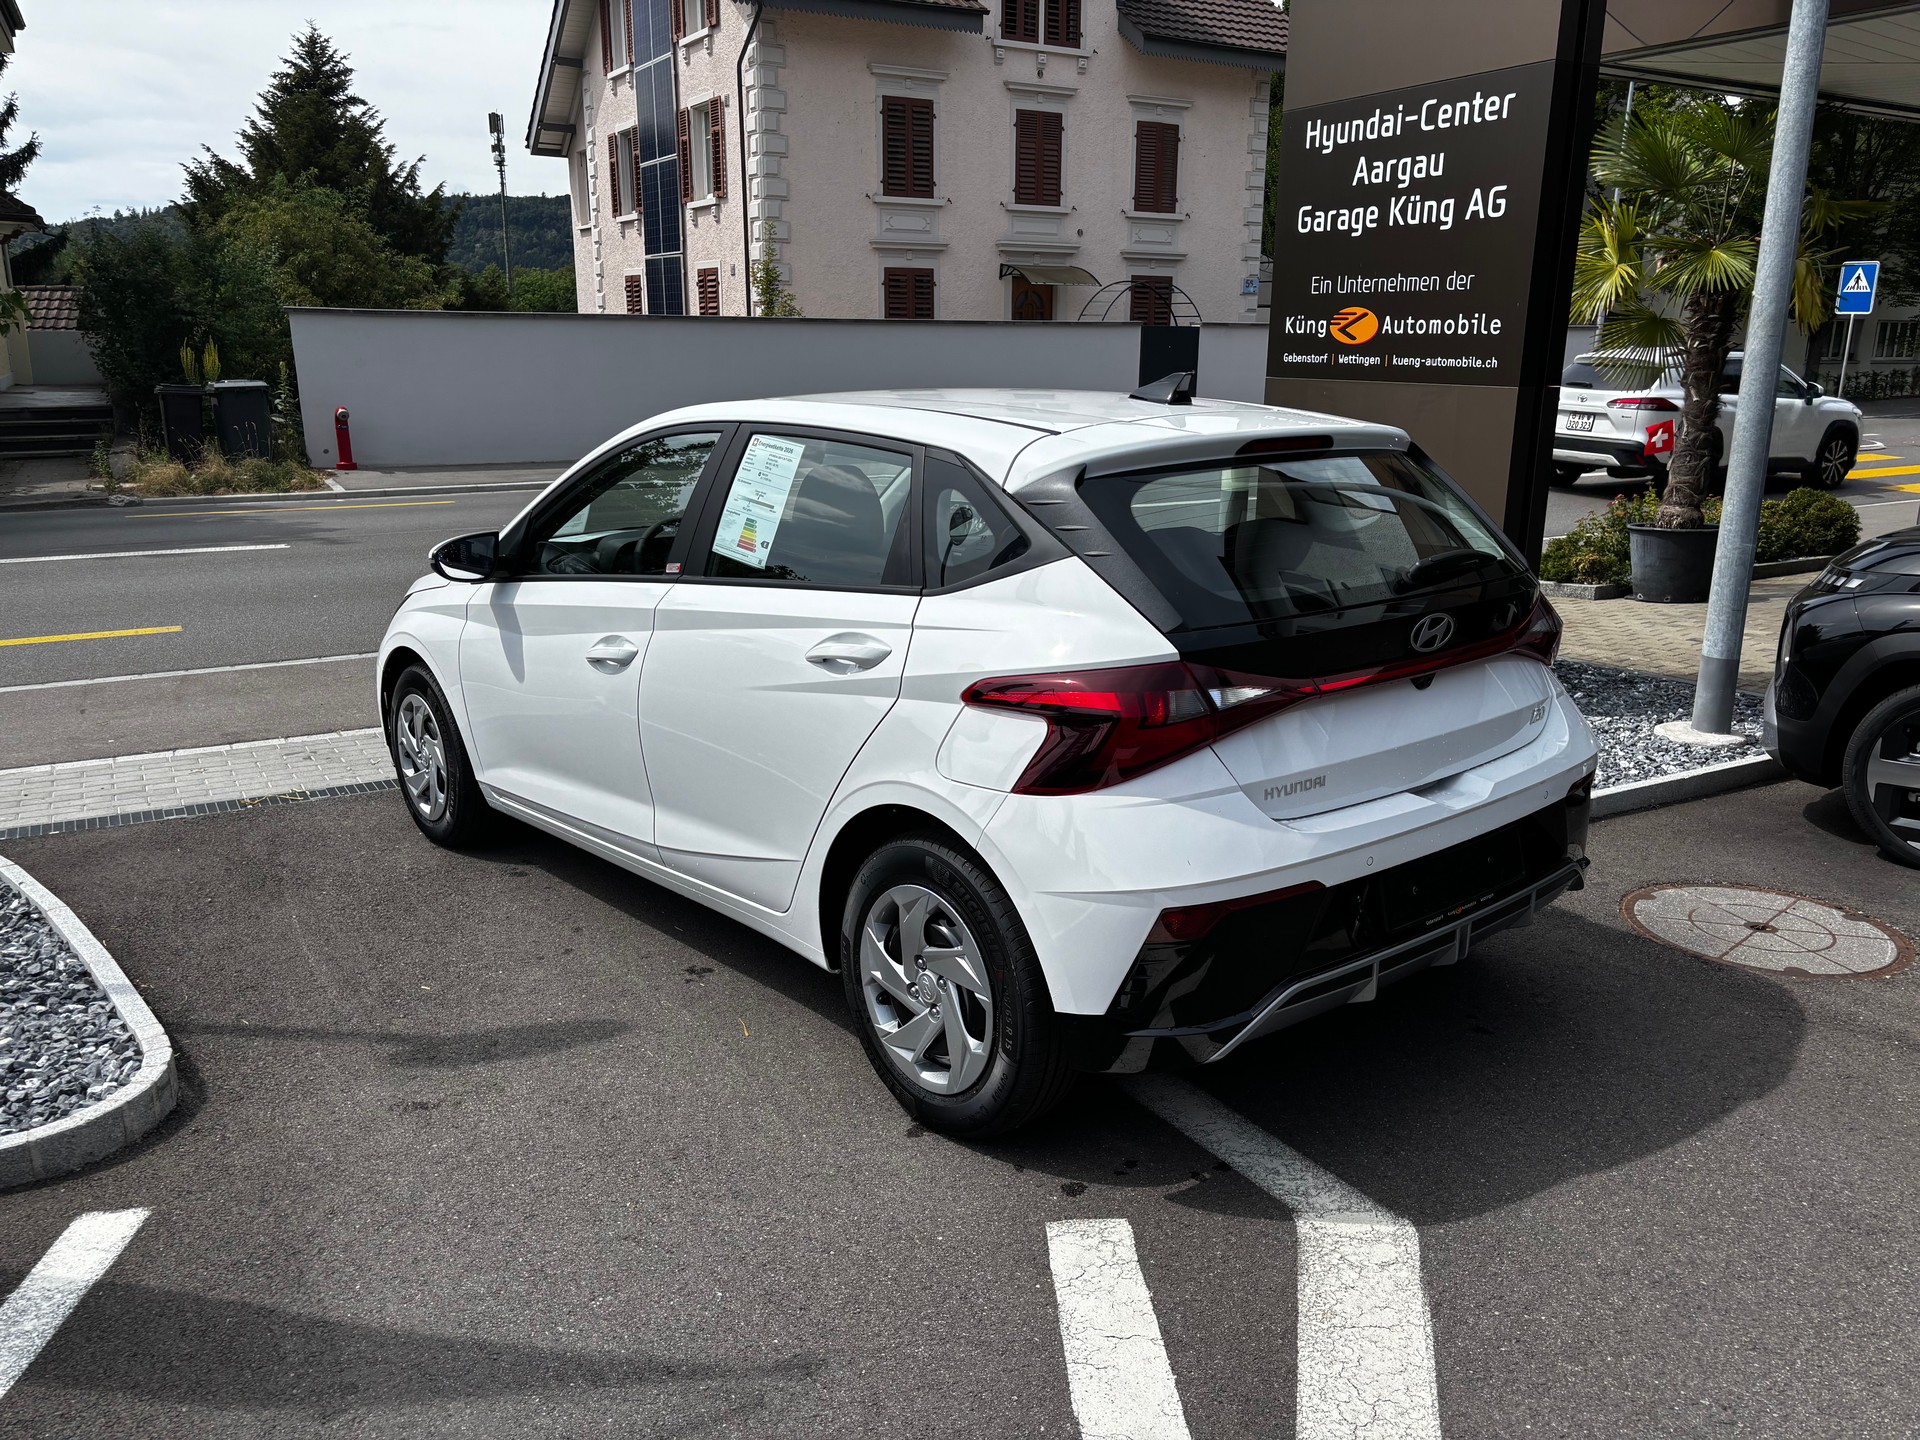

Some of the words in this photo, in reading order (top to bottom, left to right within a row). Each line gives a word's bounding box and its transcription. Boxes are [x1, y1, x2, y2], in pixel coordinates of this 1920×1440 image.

[1306, 91, 1517, 155] Hyundai-Center
[1352, 152, 1445, 188] Aargau
[1297, 205, 1379, 237] Garage
[1388, 194, 1455, 231] Küng
[1464, 184, 1508, 221] AG
[1310, 276, 1332, 295] Ein
[1337, 273, 1440, 294] Unternehmen
[1446, 270, 1476, 291] der
[1285, 314, 1327, 338] Küng
[1382, 312, 1502, 336] Automobile
[1283, 352, 1329, 364] Gebenstorf
[1338, 353, 1381, 367] Wettingen
[1392, 355, 1498, 369] kueng-automobile.ch
[1264, 775, 1327, 801] HYUNDAI
